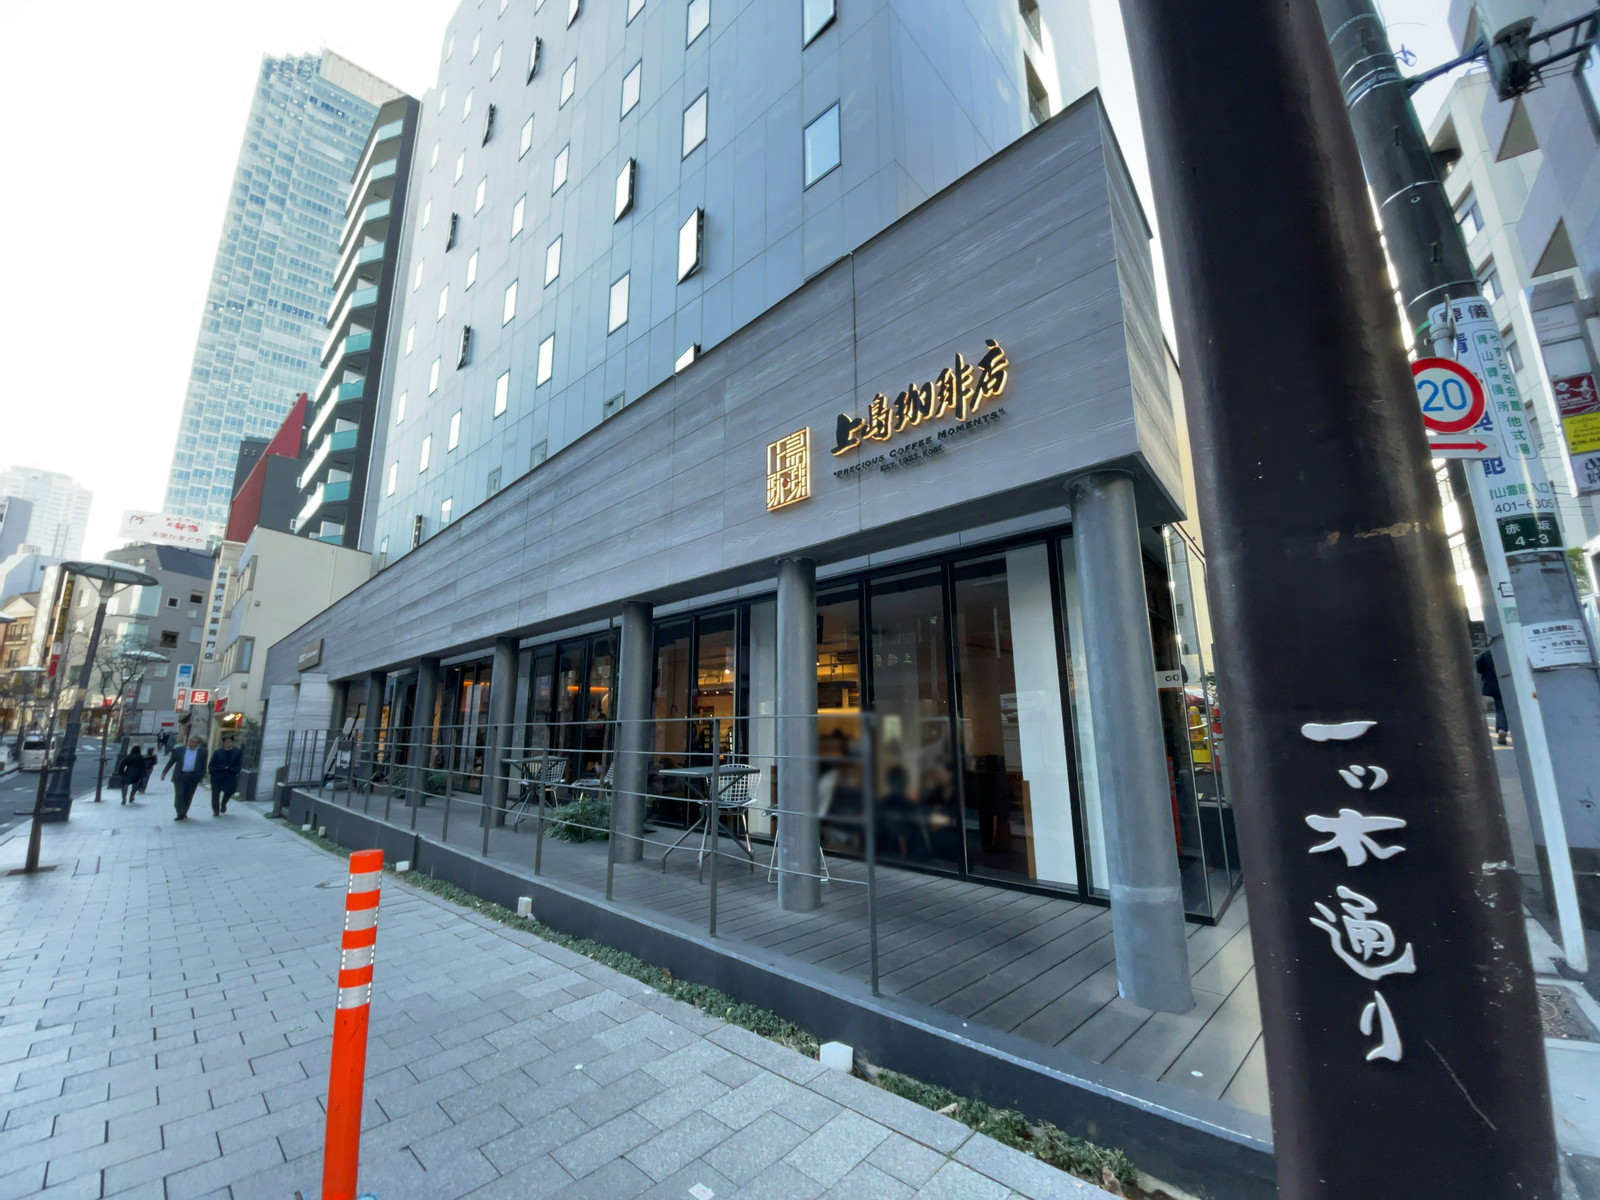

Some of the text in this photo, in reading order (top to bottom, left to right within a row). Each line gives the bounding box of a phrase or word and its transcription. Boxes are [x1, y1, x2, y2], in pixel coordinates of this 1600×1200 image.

[830, 338, 1009, 455] 上島珈琲店
[1416, 379, 1467, 412] 20
[889, 436, 932, 458] COFFEE
[1495, 499, 1554, 513] 401-6305
[1505, 520, 1551, 535] 赤坂
[1515, 534, 1550, 546] 4-3
[1301, 720, 1417, 1062] 一ツ木通り
